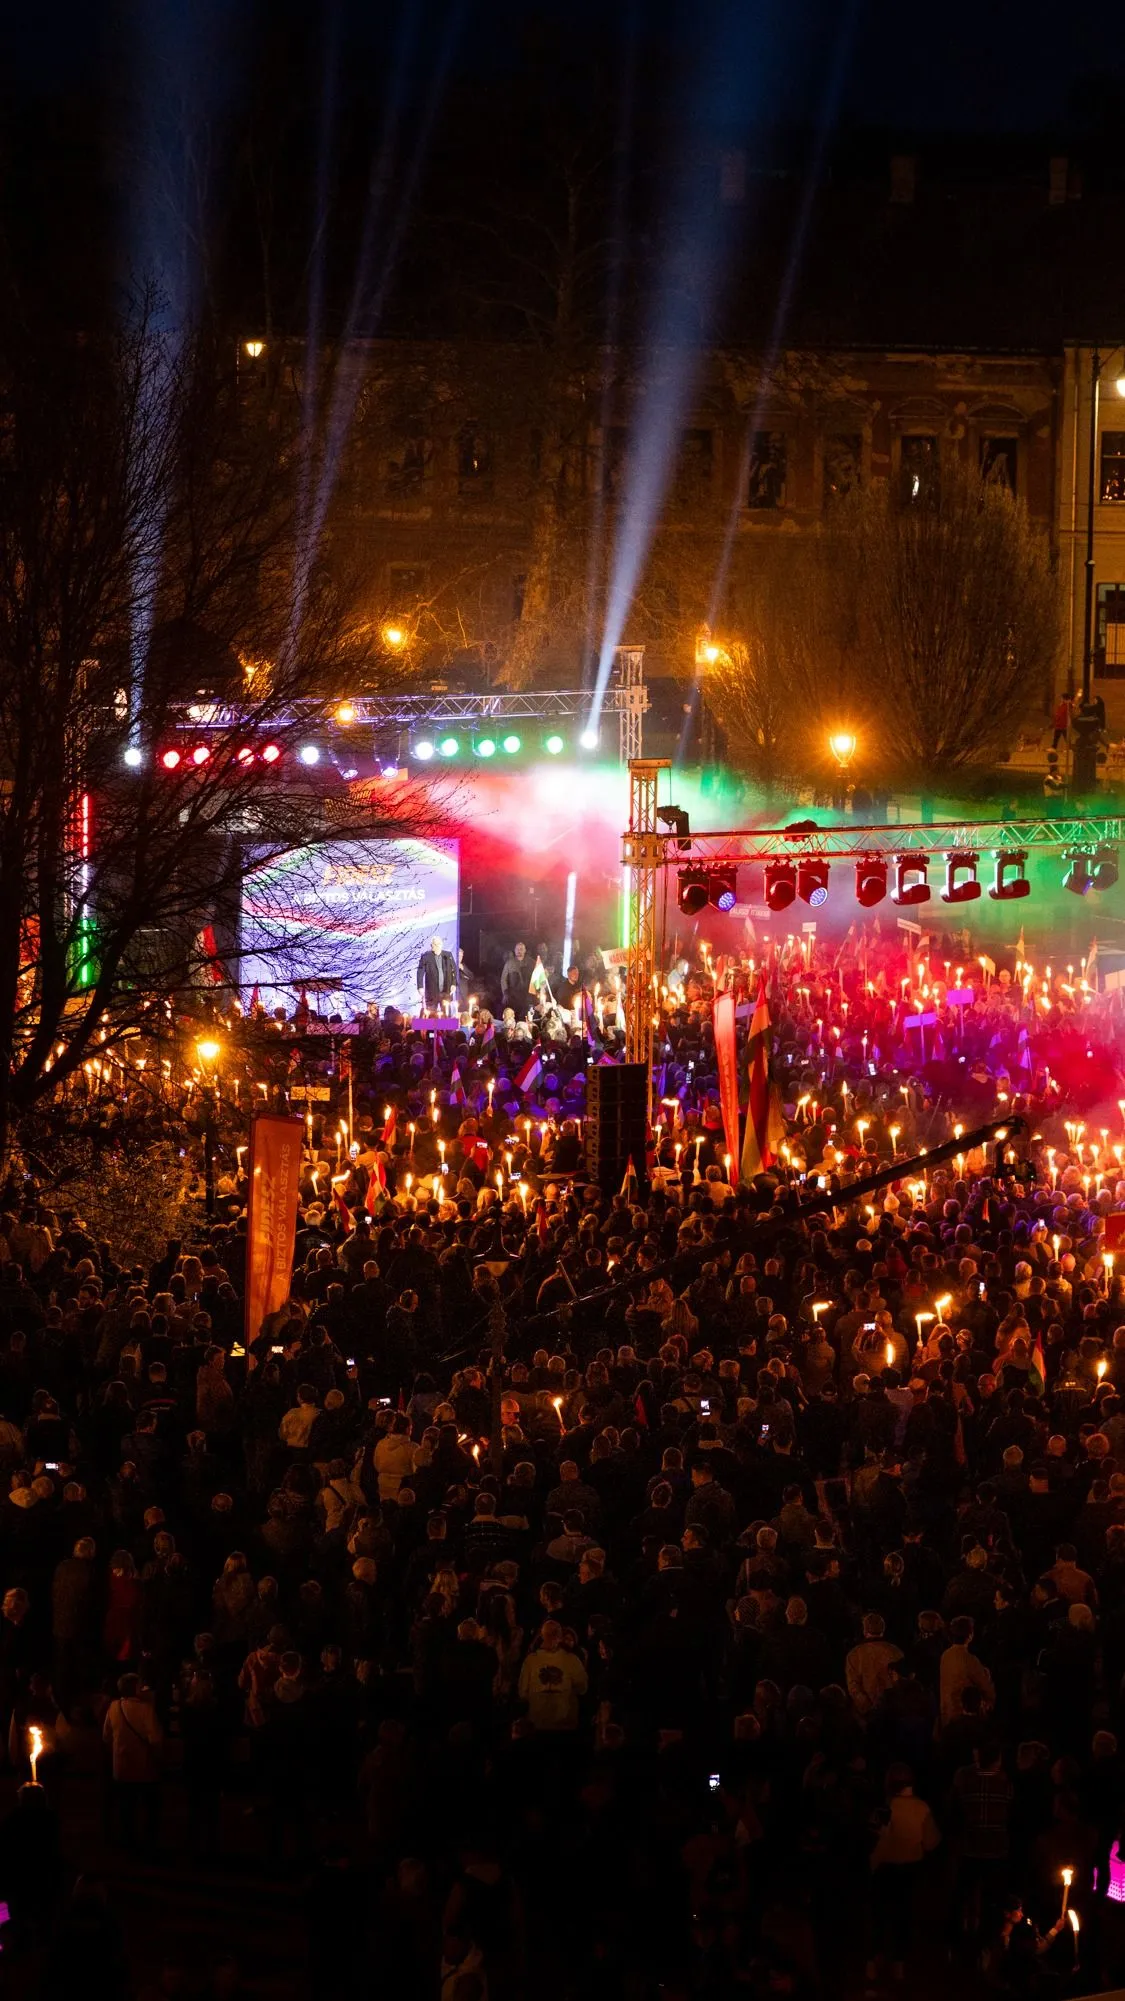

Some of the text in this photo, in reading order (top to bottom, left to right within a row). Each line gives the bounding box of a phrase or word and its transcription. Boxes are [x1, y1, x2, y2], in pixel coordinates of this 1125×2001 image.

[353, 887, 425, 902] VÁLASZTÁS
[260, 1171, 275, 1246] FIDESZ
[276, 1143, 291, 1281] A BIZTOS VÁLASZTÁS
